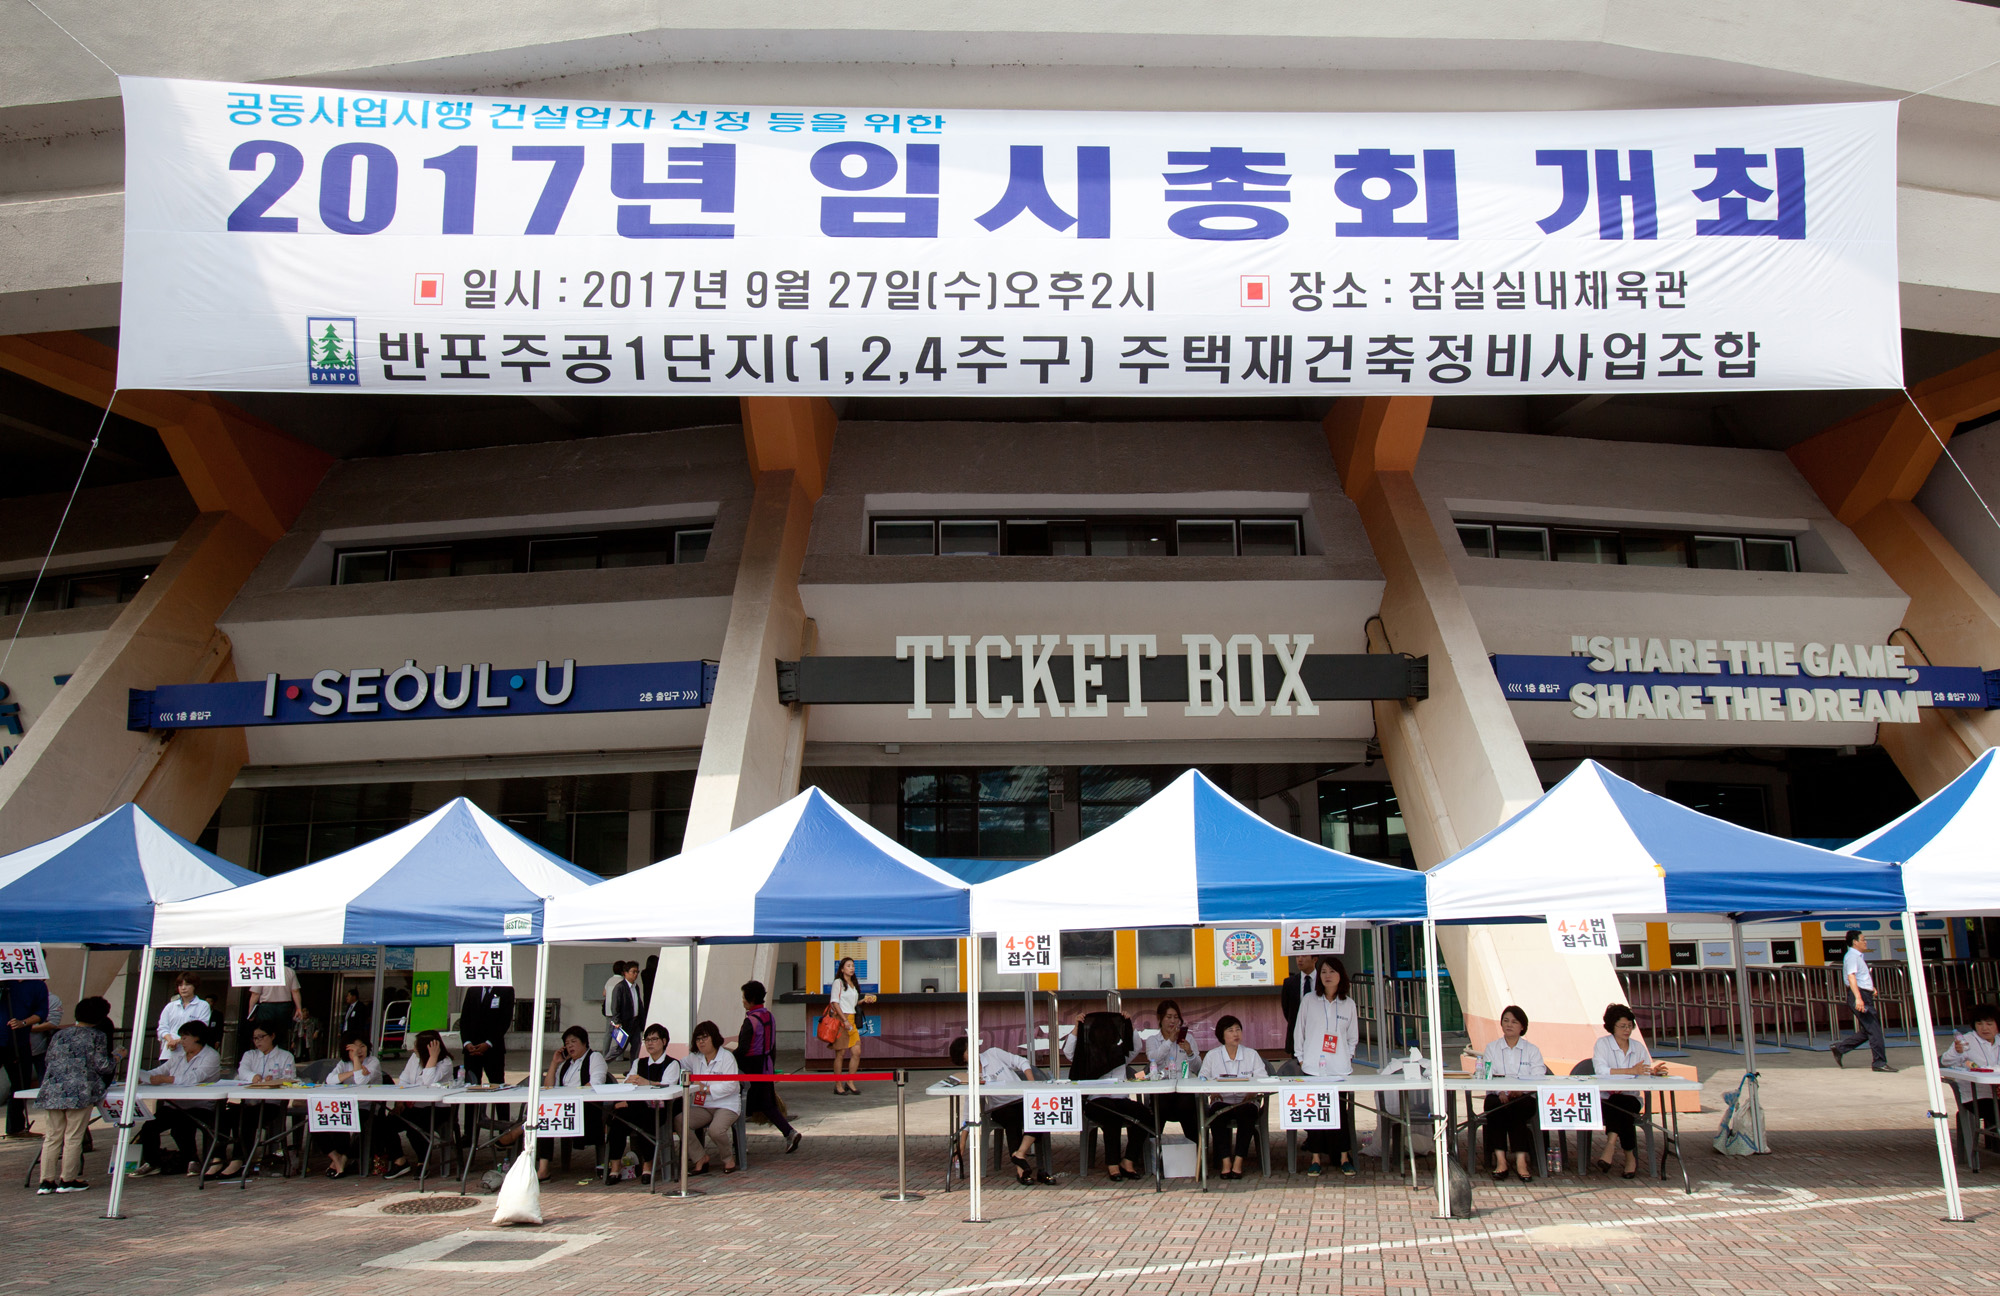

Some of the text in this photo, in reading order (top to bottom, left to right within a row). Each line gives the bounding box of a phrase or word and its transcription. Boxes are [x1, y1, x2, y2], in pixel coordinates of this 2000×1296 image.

[227, 91, 947, 134] 공동사업시행 건설업자 선정 등을 위한
[227, 140, 737, 239] 2017년
[1535, 147, 1807, 241] 개최
[464, 269, 541, 310] 일시
[584, 269, 727, 310] 2017년
[747, 270, 810, 310] 9월
[1289, 271, 1368, 312] 장소
[1409, 270, 1688, 311] 잠실실내체육관
[379, 331, 1762, 385] 반포주공1단지(1,2,4주구) 주택재건축정비사업조합
[312, 372, 355, 382] BANPO
[1723, 640, 1799, 676] THE
[1801, 642, 1919, 684] GAME,
[896, 634, 1320, 720] TICKET BOX
[1570, 682, 1707, 720] SHARE
[1705, 686, 1785, 721] THE
[1289, 925, 1337, 939] 4-5번
[1557, 918, 1606, 933] 4-4번
[1005, 934, 1051, 951] 4-6번
[1291, 938, 1335, 951] 접수대
[1561, 934, 1608, 948] 접수대
[237, 951, 276, 966] 4-8번
[462, 950, 503, 965] 4-7번
[1007, 951, 1050, 967] 접수대
[239, 966, 276, 980] 접수대
[464, 965, 503, 980] 접수대
[1031, 1096, 1074, 1111] 4-6번
[1287, 1092, 1331, 1107] 4-5번
[1546, 1092, 1592, 1107] 4-4번
[314, 1101, 353, 1114] 4-8번
[538, 1103, 576, 1116] 4-7번
[317, 1113, 353, 1127] 접수대
[1033, 1111, 1073, 1126] 접수대
[1289, 1108, 1331, 1123] 접수대
[1549, 1108, 1592, 1123] 접수대
[538, 1117, 575, 1131] 접수대
